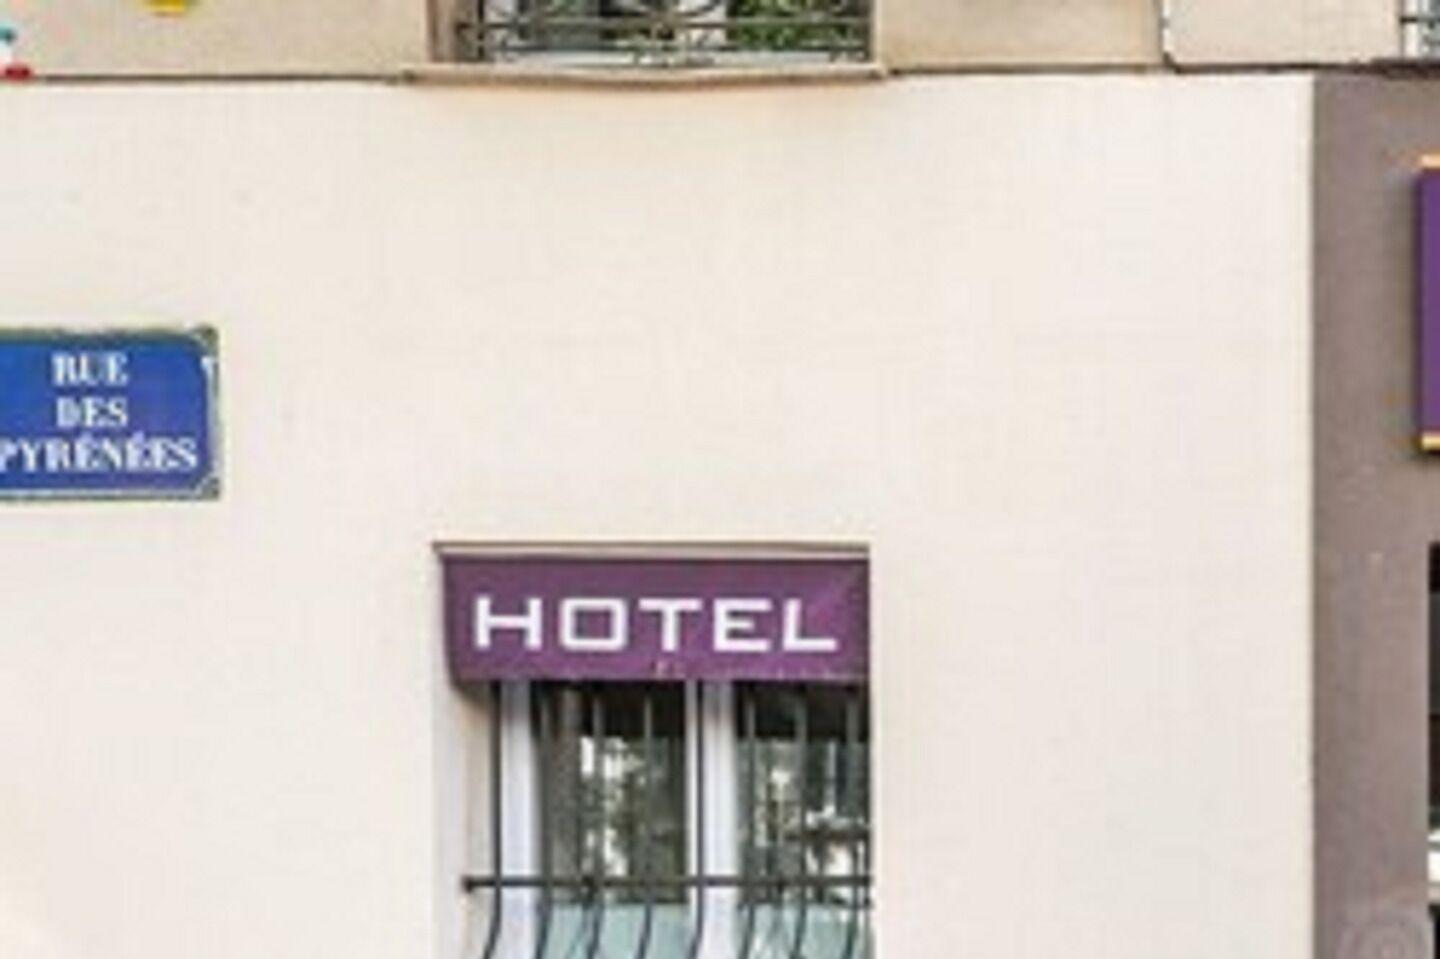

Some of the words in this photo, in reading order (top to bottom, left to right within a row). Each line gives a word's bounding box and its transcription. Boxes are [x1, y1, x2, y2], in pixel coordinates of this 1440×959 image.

[52, 353, 129, 386] RUE
[56, 396, 129, 428] DES
[474, 596, 838, 652] HOTEL
